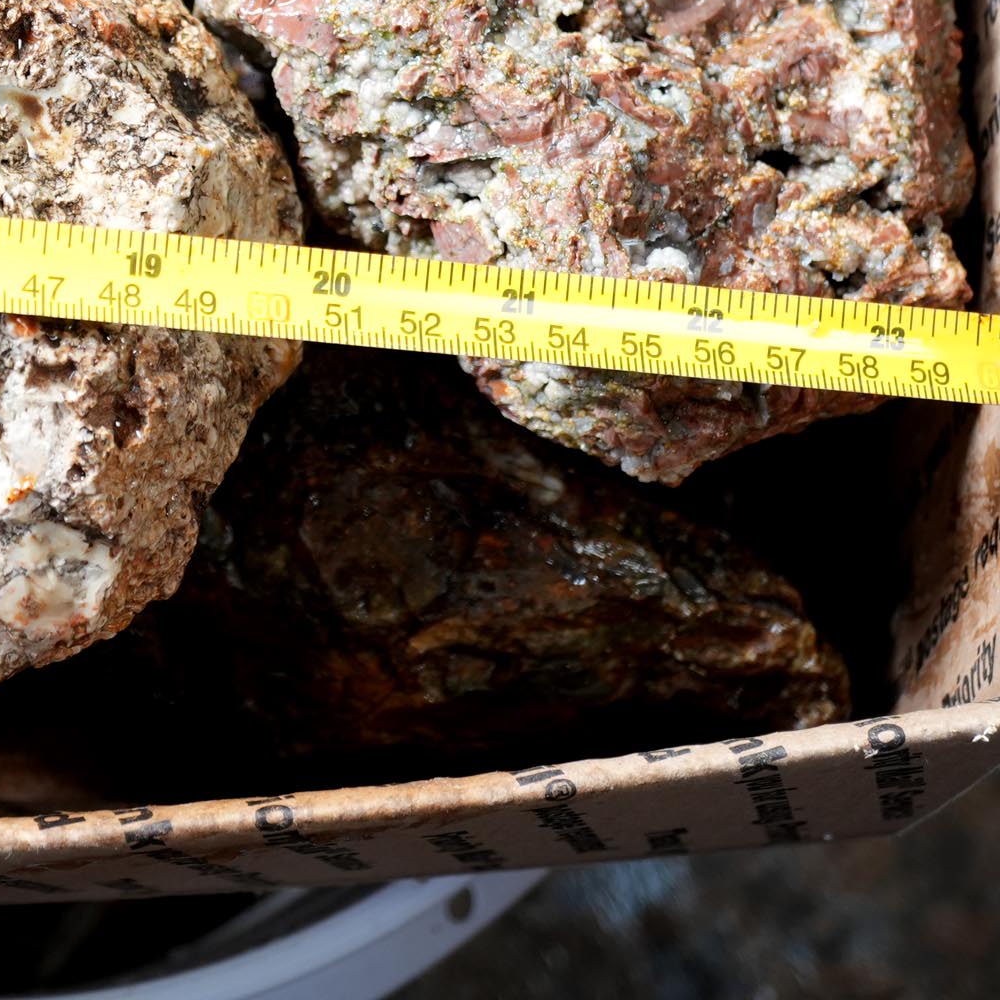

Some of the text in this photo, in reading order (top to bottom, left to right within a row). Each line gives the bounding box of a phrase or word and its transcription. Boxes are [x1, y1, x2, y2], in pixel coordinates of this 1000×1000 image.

[20, 274, 66, 301] 47
[98, 281, 142, 308] 48
[173, 288, 218, 316] 49
[324, 303, 364, 331] 51
[399, 310, 443, 337] 52
[474, 317, 518, 345] 53
[548, 325, 590, 351] 54
[620, 332, 663, 360] 55
[694, 339, 737, 366] 56
[766, 346, 808, 373] 57
[838, 353, 881, 379] 58
[910, 359, 951, 386] 59
[126, 252, 163, 279] 19
[312, 270, 352, 298] 20
[501, 287, 536, 316] 21
[686, 306, 725, 334] 22
[869, 324, 906, 351] 23
